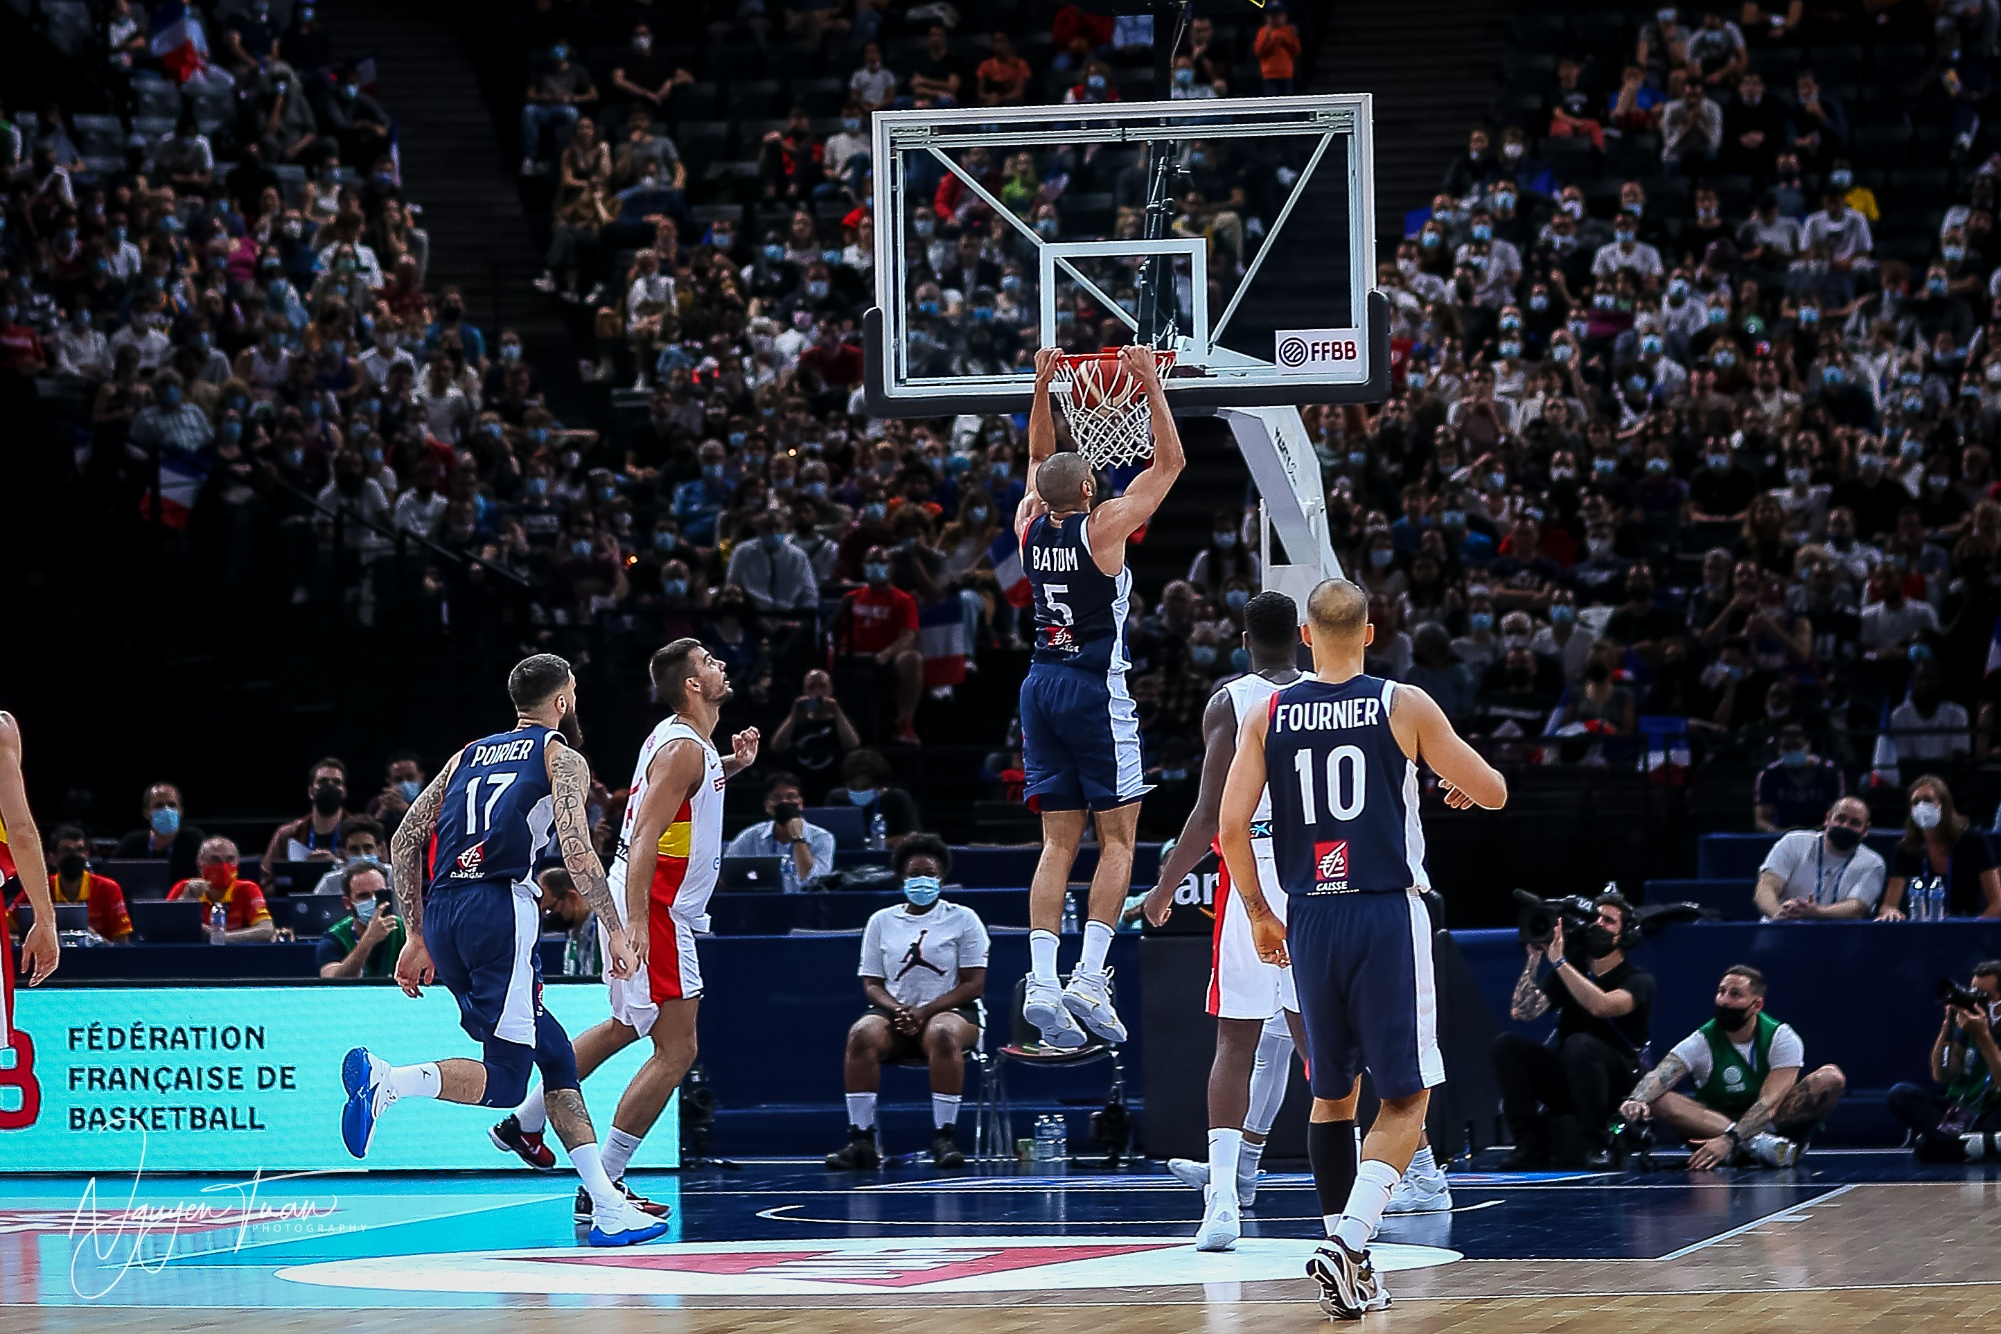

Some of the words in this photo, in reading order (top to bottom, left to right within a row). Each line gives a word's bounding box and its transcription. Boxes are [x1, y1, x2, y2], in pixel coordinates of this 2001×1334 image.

[1311, 341, 1357, 362] FFBB
[1032, 545, 1079, 572] BATUM
[1042, 583, 1074, 627] 5
[1275, 698, 1380, 734] FOURNIER
[469, 739, 534, 768] POIRIER
[1294, 745, 1367, 825] 10
[466, 772, 518, 835] 17
[1315, 881, 1348, 891] CAISSE
[68, 1021, 265, 1051] FÉDÉRATION
[68, 1066, 244, 1094] FRANÇAISE
[257, 1066, 297, 1090] DE
[68, 1106, 265, 1131] BASKETBALL
